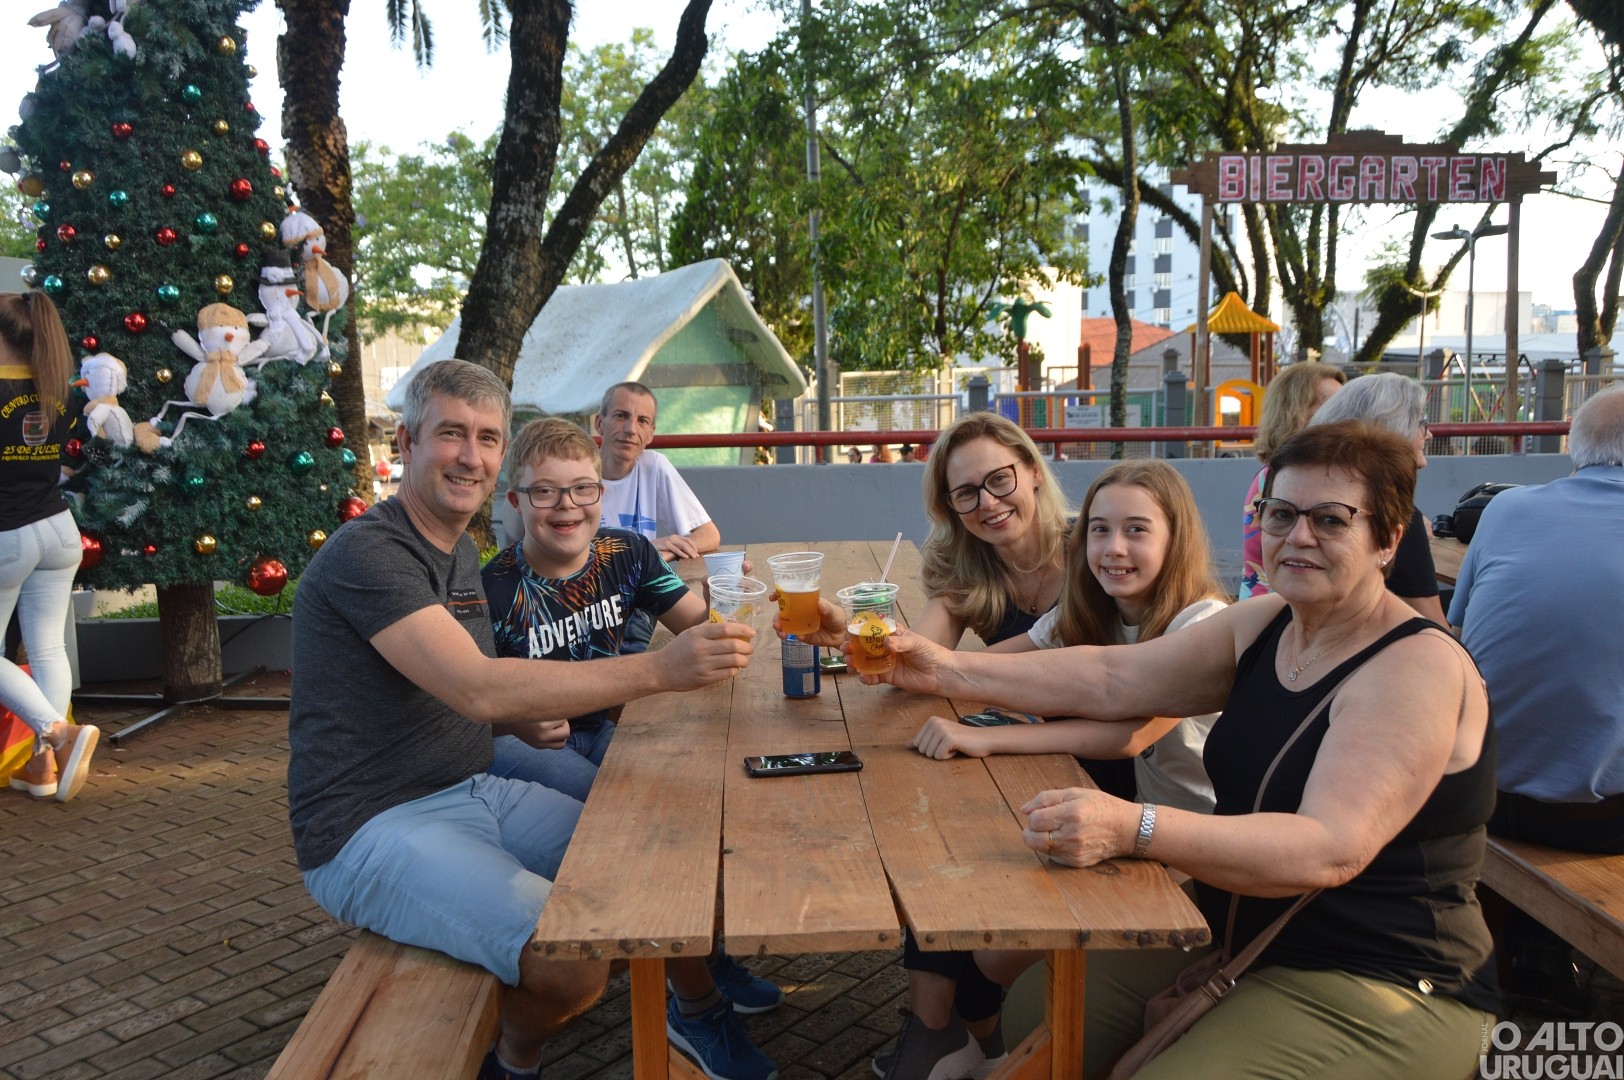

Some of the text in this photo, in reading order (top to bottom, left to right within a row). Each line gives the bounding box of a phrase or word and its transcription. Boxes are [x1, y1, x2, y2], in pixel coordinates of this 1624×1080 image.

[1218, 155, 1507, 201] BIERGARTEN
[1, 394, 30, 419] CENTRO
[3, 445, 16, 455] 25
[17, 445, 32, 455] DE
